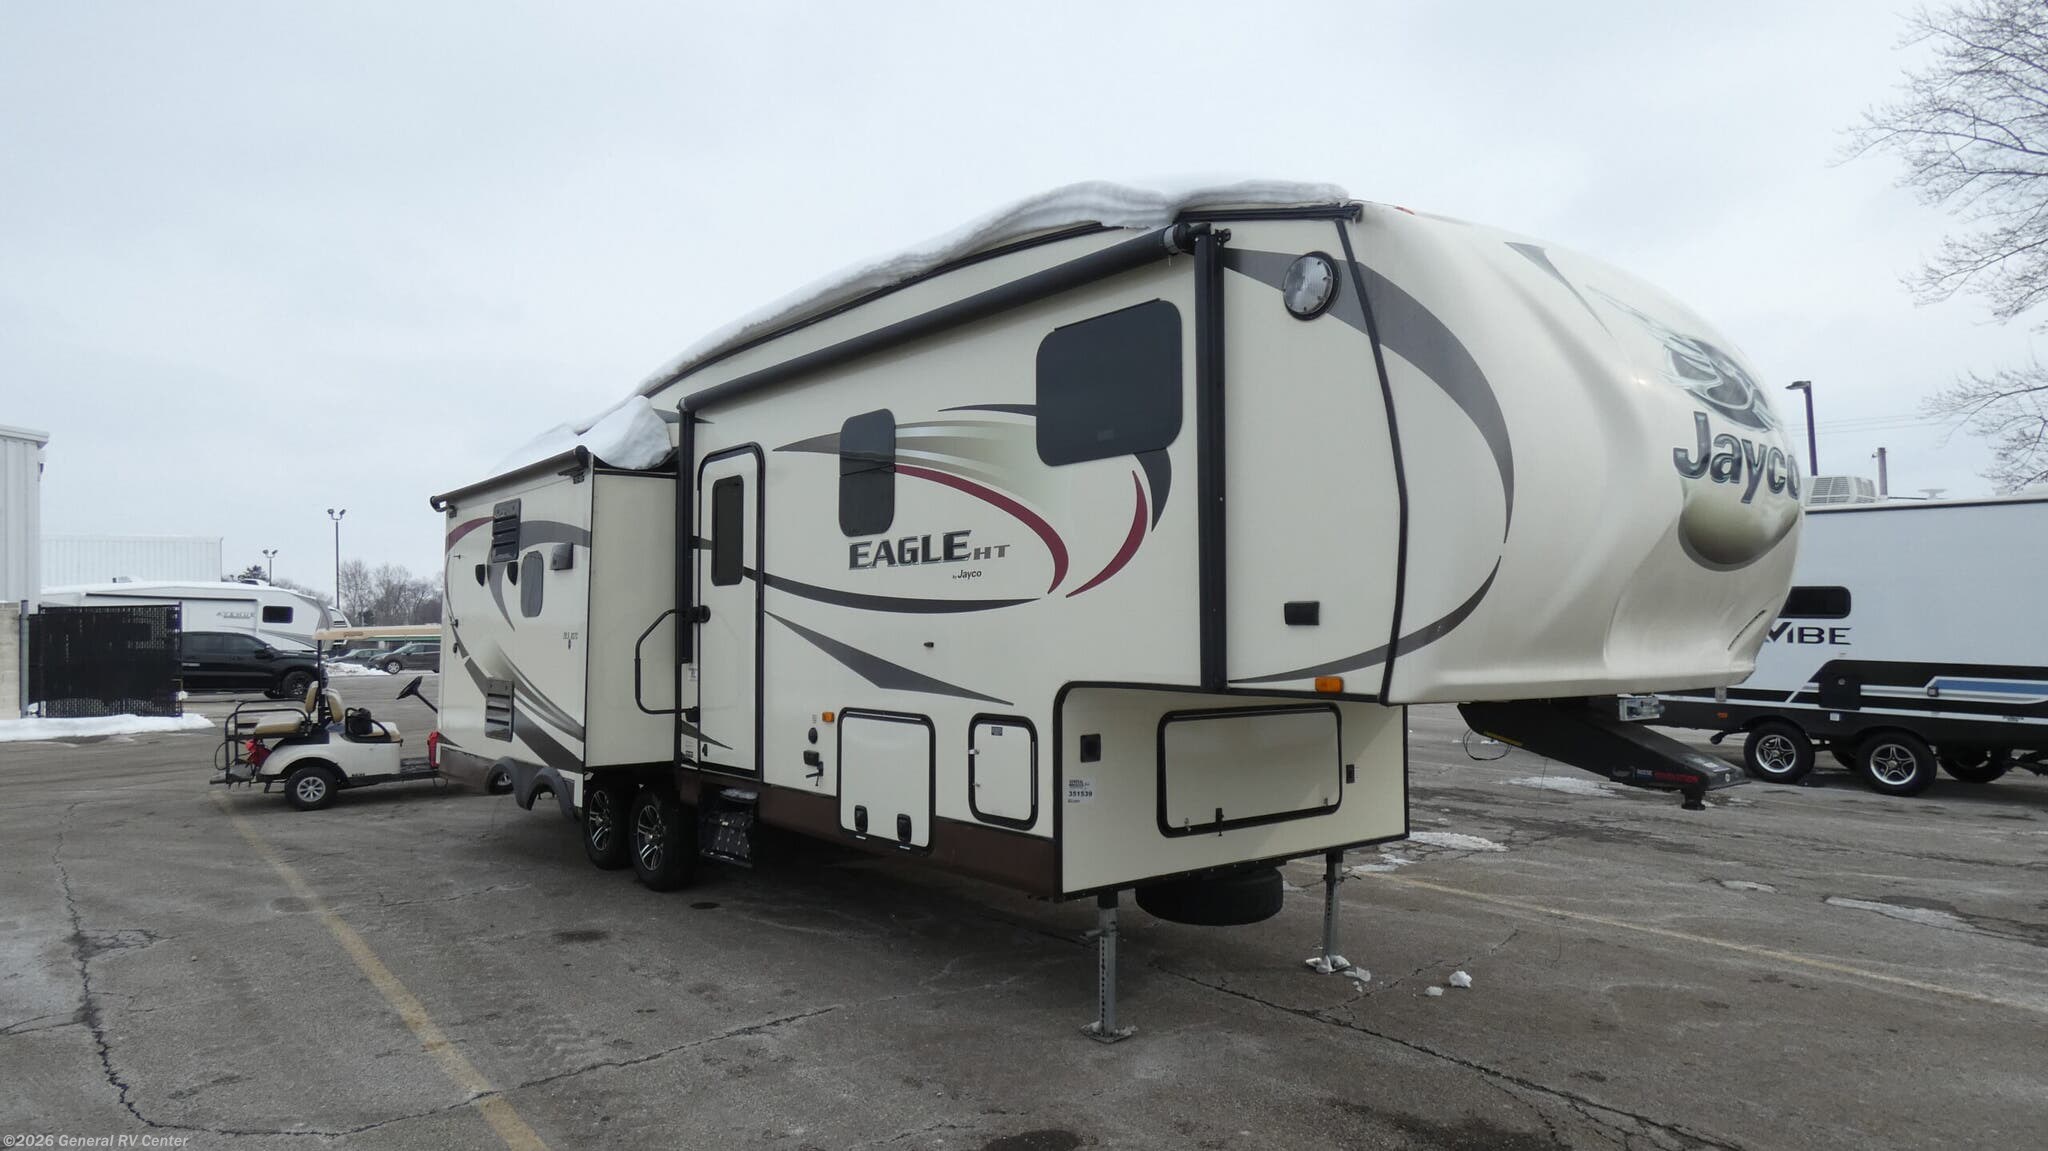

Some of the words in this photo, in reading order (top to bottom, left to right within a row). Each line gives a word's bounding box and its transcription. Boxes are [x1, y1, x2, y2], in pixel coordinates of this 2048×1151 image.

[1672, 410, 1800, 504] Jayco
[849, 529, 972, 570] EAGLE
[973, 544, 1011, 560] HT
[958, 569, 982, 580] Jayco
[1767, 621, 1852, 646] VIBE
